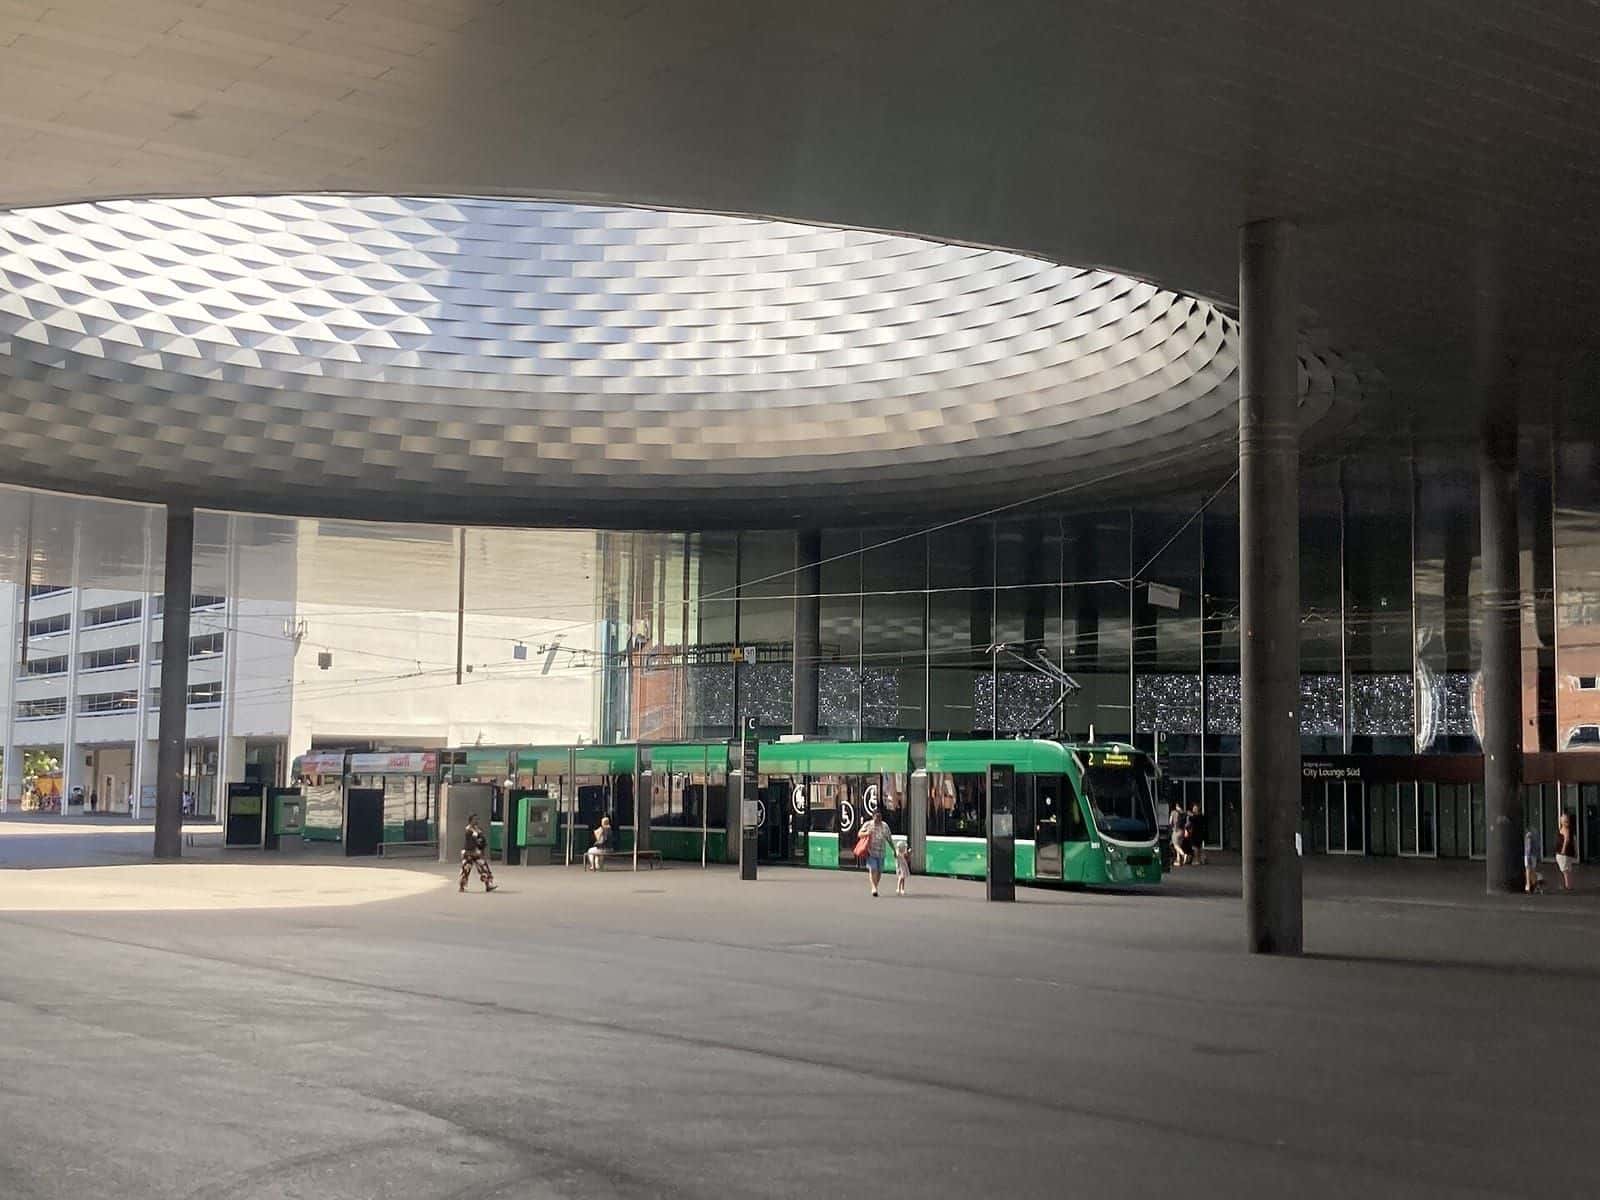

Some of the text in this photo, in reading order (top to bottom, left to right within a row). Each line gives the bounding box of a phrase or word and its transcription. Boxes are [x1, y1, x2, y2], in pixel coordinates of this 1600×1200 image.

[749, 718, 756, 729] C
[1088, 752, 1094, 766] 2
[1303, 768, 1318, 779] City
[1319, 768, 1345, 779] Lounge
